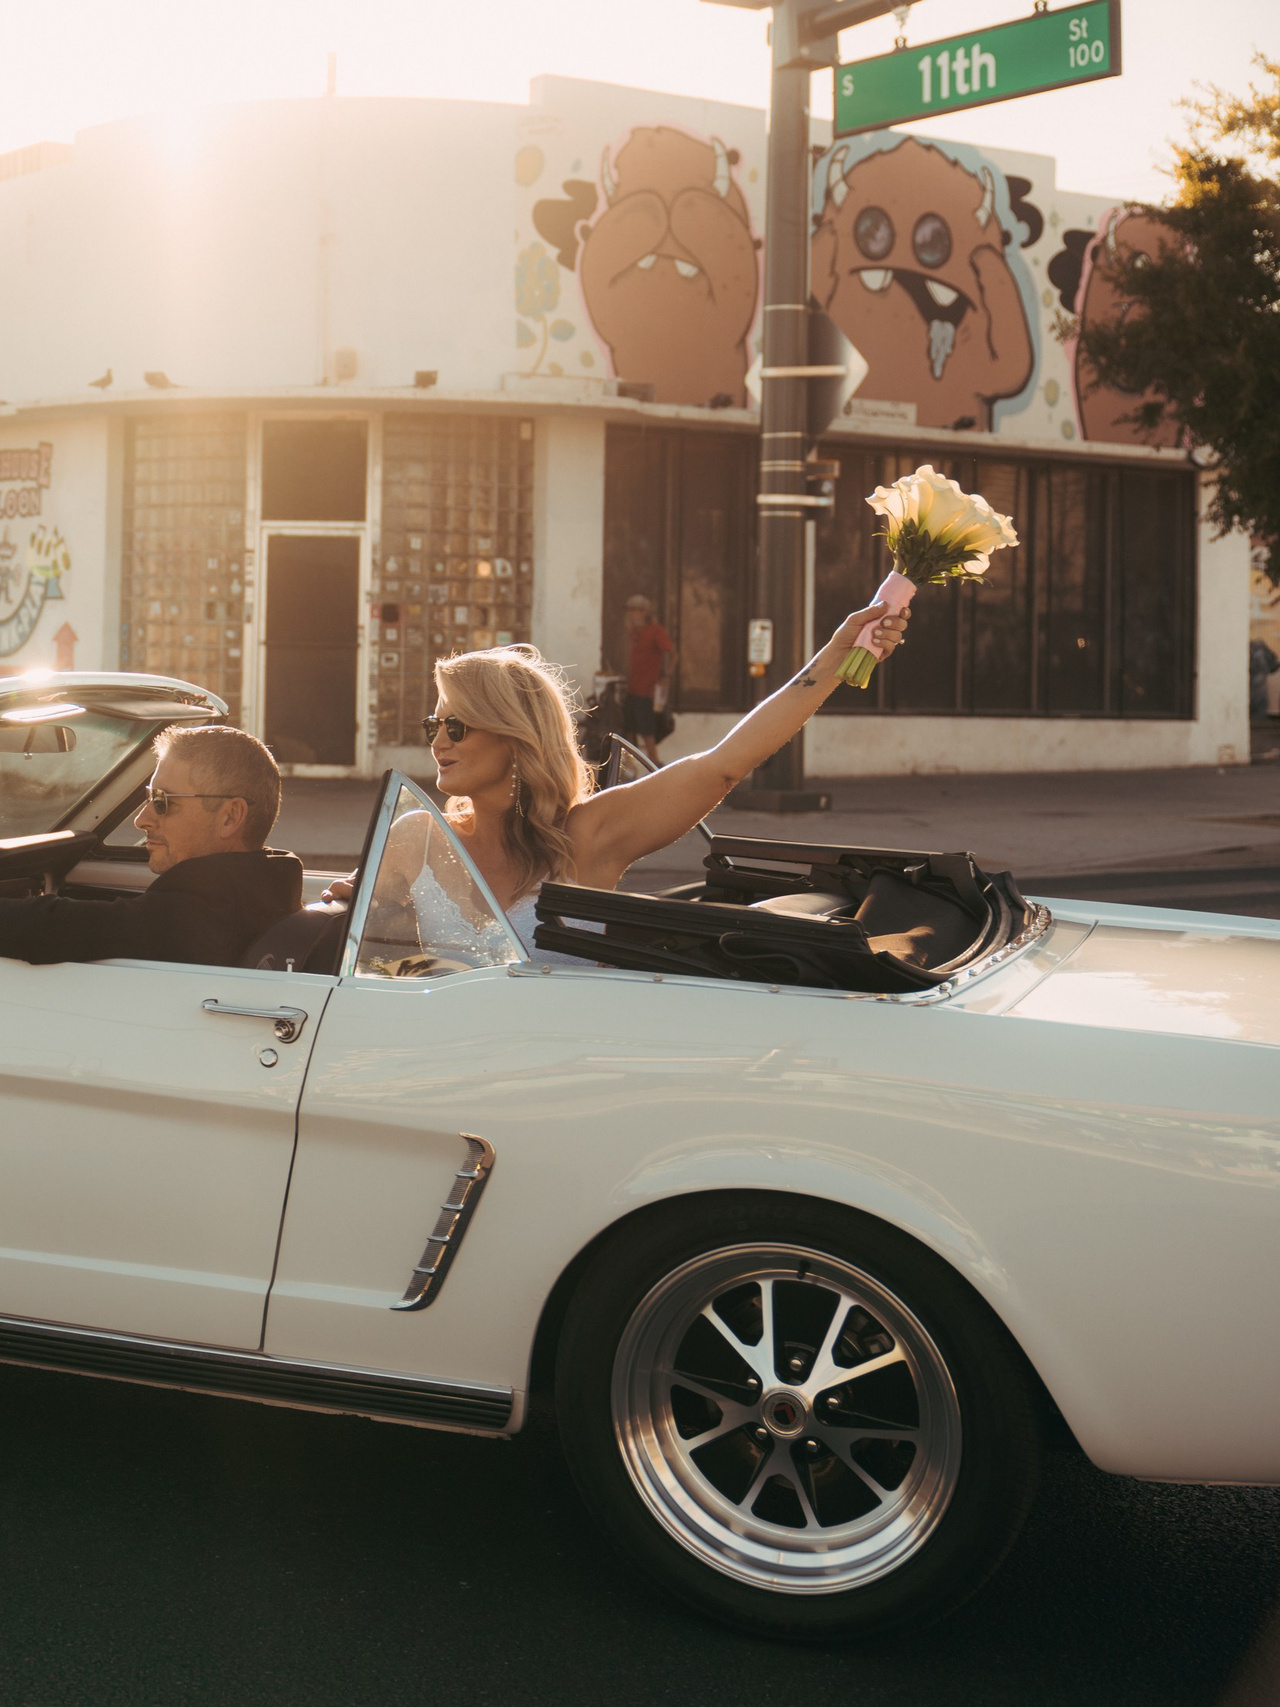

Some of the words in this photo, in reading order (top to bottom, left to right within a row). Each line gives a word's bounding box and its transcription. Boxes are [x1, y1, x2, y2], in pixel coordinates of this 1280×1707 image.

[841, 74, 855, 97] S
[918, 43, 997, 103] 11th
[1068, 17, 1089, 41] St
[1068, 40, 1105, 68] 100
